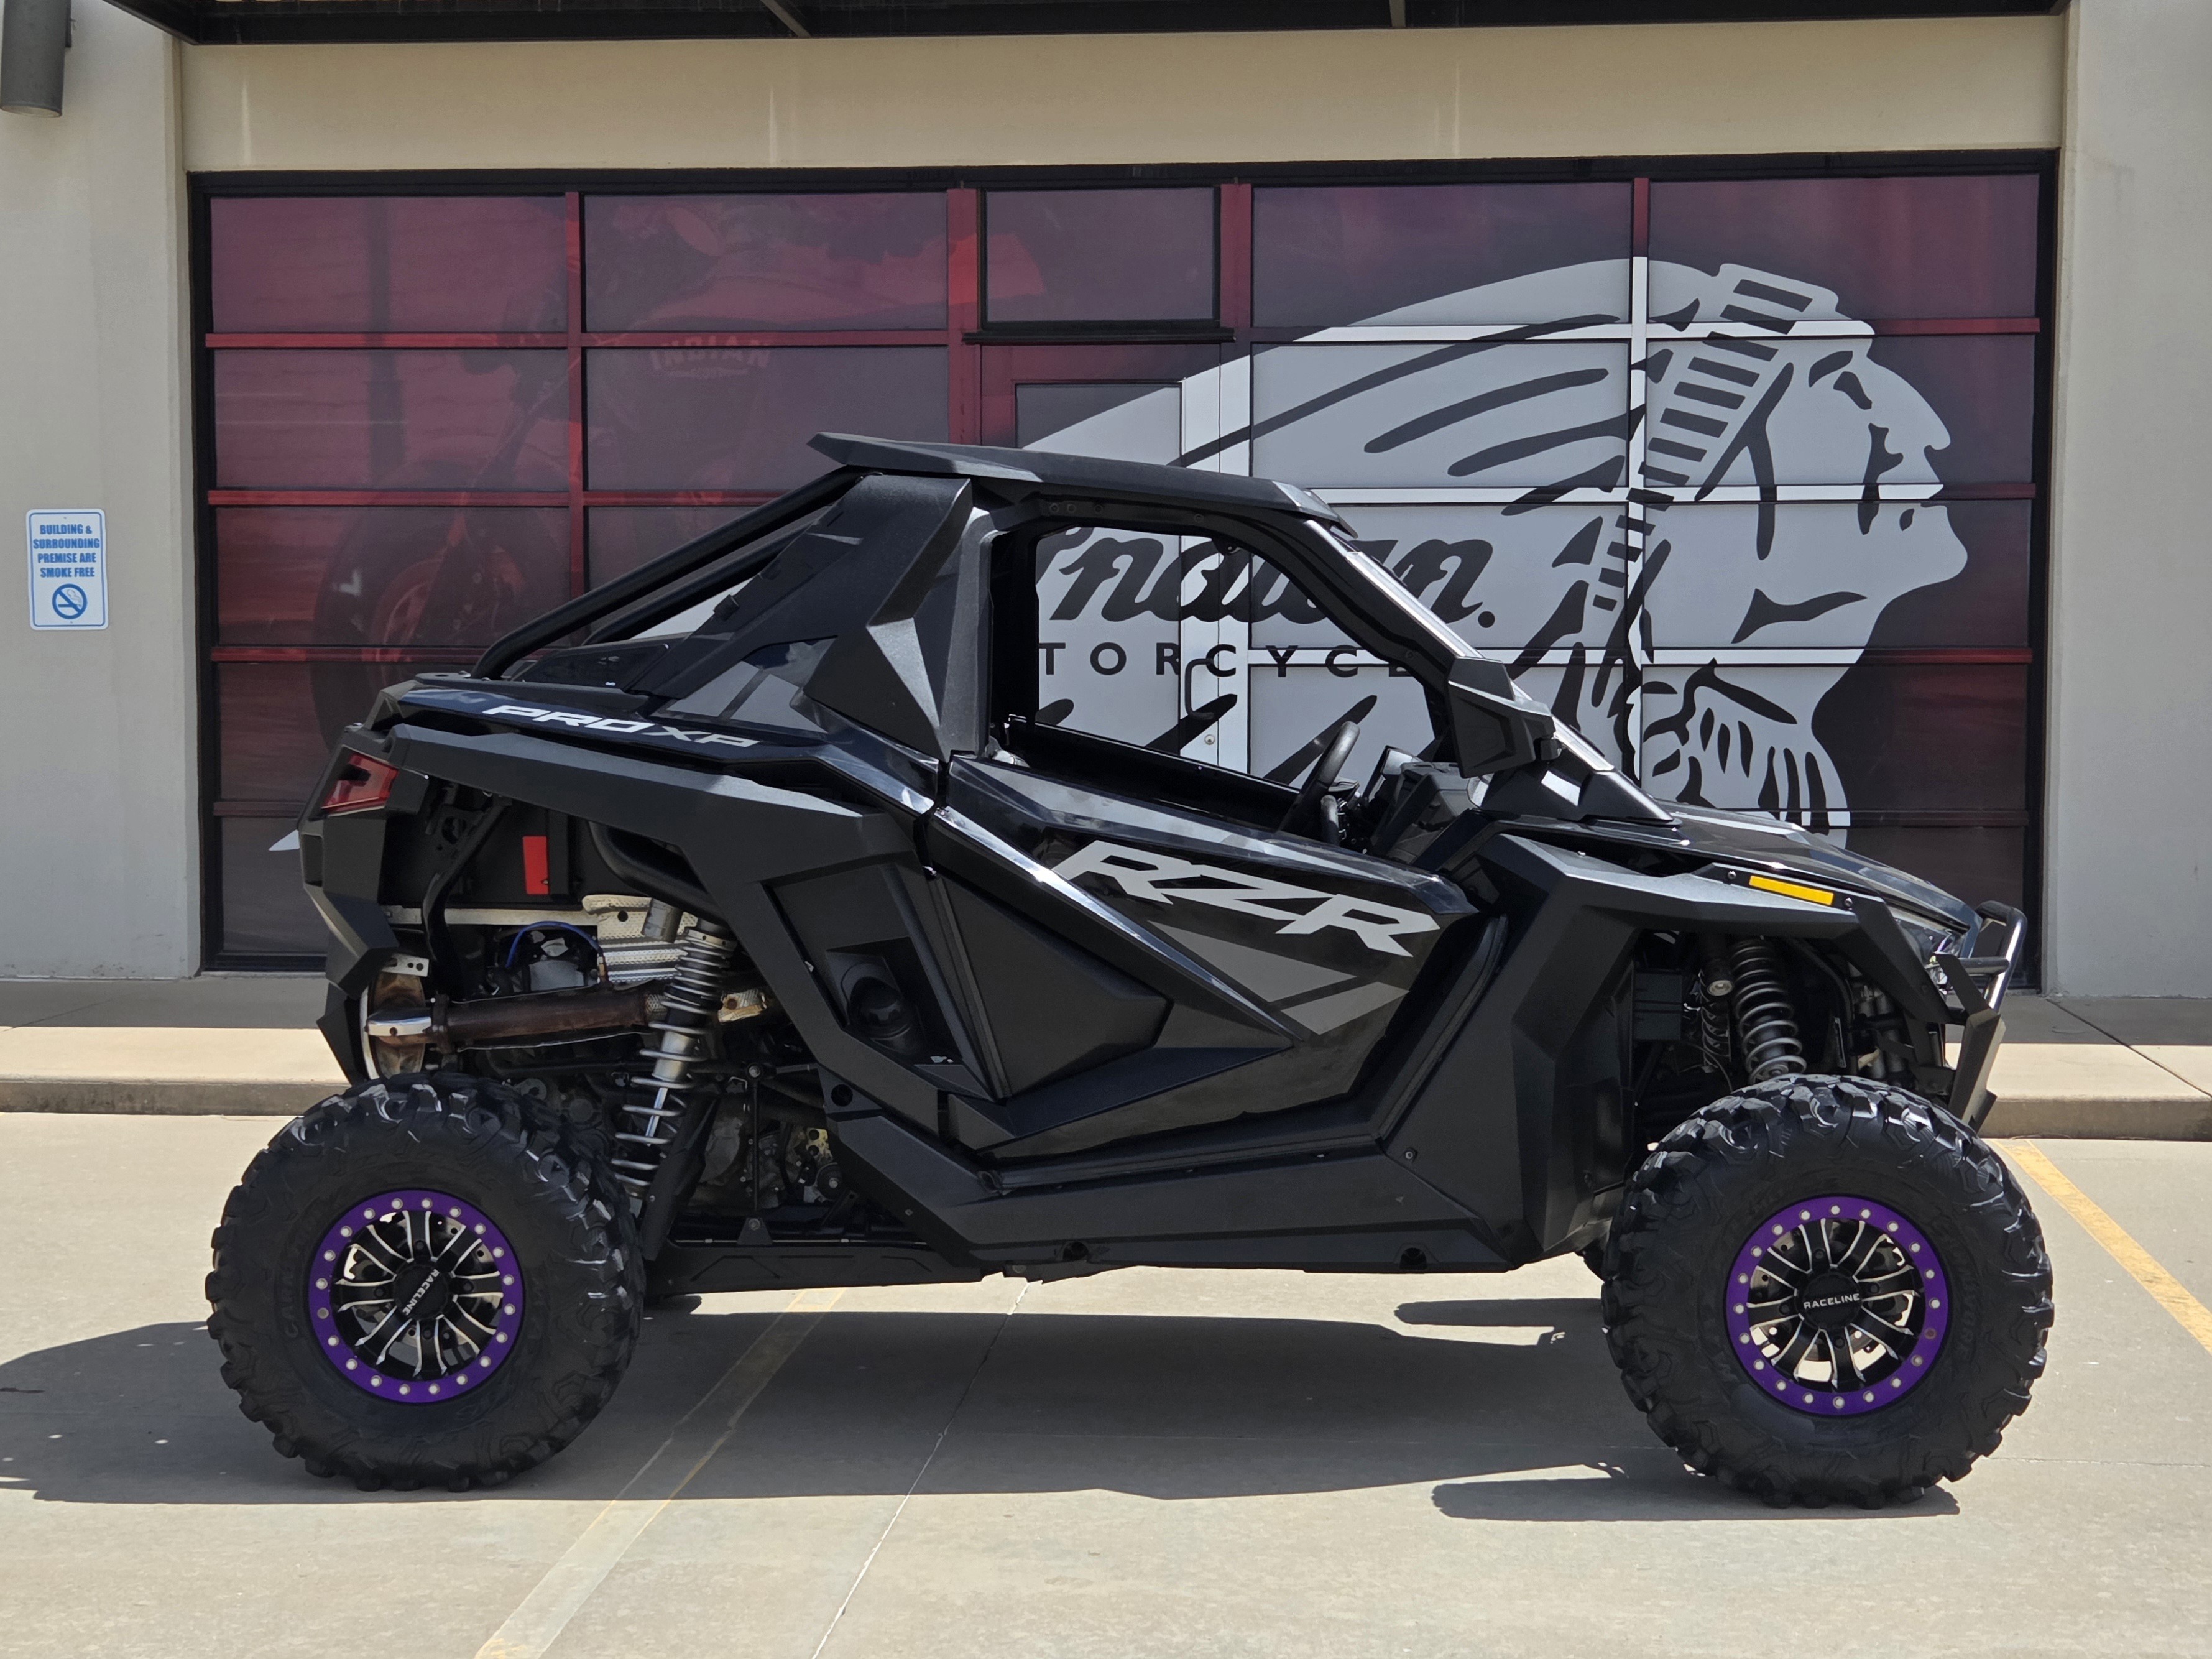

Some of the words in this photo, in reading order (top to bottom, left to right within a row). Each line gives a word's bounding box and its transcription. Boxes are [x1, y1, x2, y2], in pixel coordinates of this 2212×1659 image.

[40, 524, 84, 535] BUILDING
[85, 525, 93, 534] &
[33, 538, 100, 549] SURROUNDING
[37, 553, 78, 563] PREMISE
[79, 553, 97, 563] ARE
[40, 567, 72, 578] SMOKE
[74, 567, 95, 578] FREE
[482, 705, 655, 733] PRO
[641, 726, 761, 748] XP
[1053, 840, 1441, 958] RZR
[402, 1269, 440, 1315] RACELINE
[1803, 1293, 1861, 1310] RACELINE
